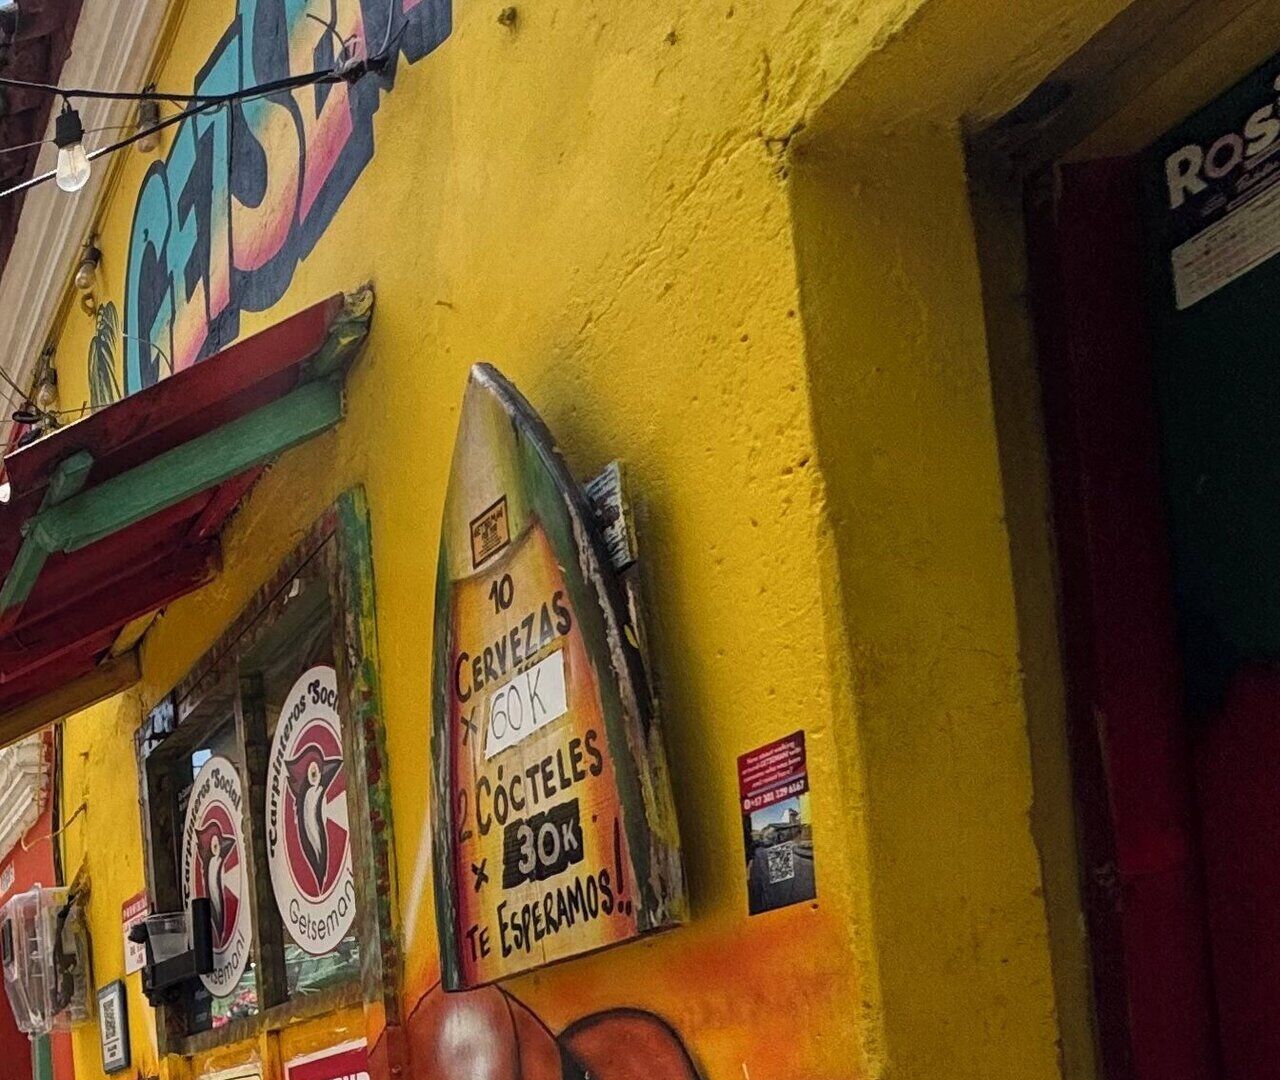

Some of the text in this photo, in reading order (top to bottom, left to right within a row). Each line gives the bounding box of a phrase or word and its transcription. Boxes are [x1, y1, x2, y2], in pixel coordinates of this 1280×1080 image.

[455, 591, 572, 703] CERVEZAS
[489, 573, 515, 614] 10
[270, 679, 340, 858] Carpinteros Soci
[476, 729, 603, 836] CÓCTELES
[465, 924, 491, 962] TE
